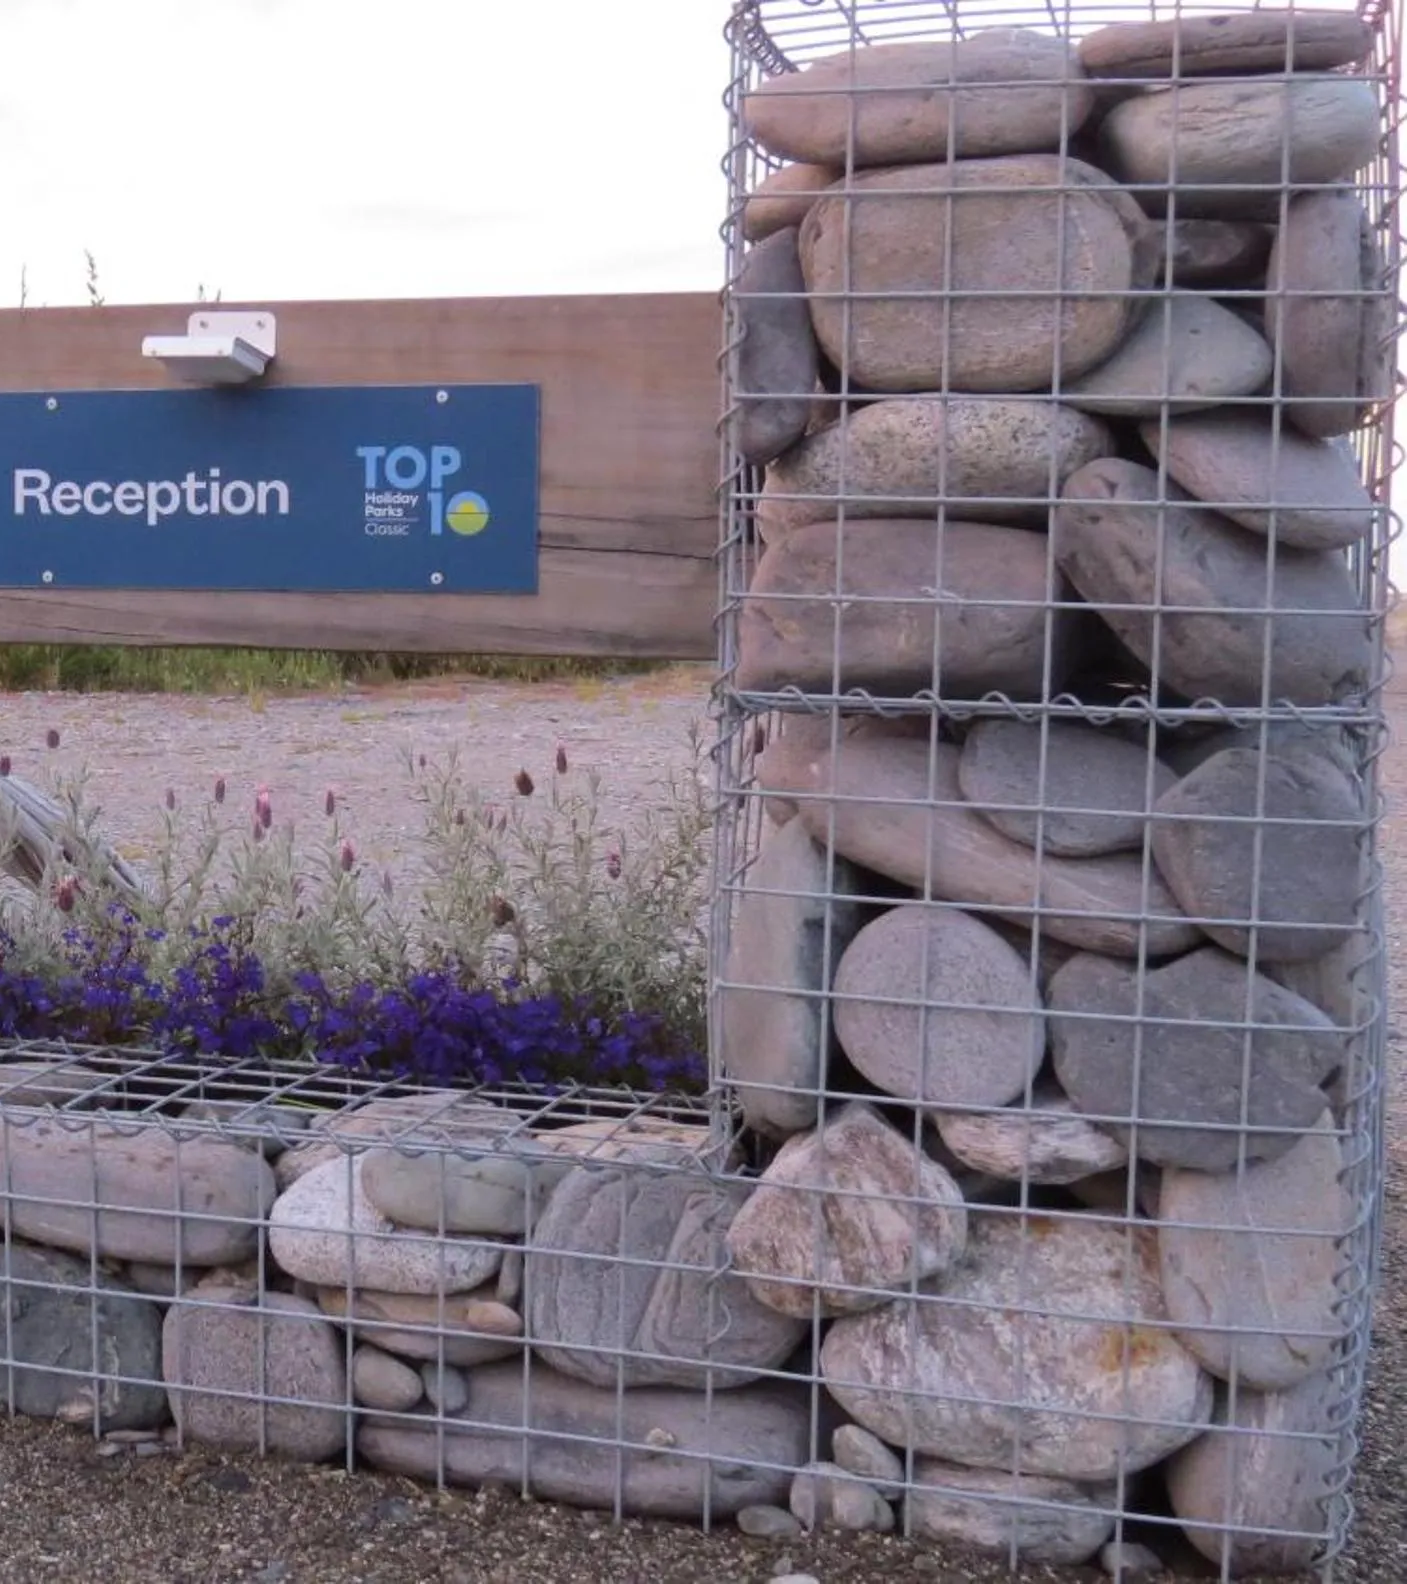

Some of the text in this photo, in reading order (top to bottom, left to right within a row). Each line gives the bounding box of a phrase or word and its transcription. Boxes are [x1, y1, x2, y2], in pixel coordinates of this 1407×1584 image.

[356, 445, 461, 489] TOP
[13, 467, 289, 525] Reception
[365, 492, 418, 508] Holiday
[365, 506, 404, 517] Parks
[364, 523, 409, 535] Classic
